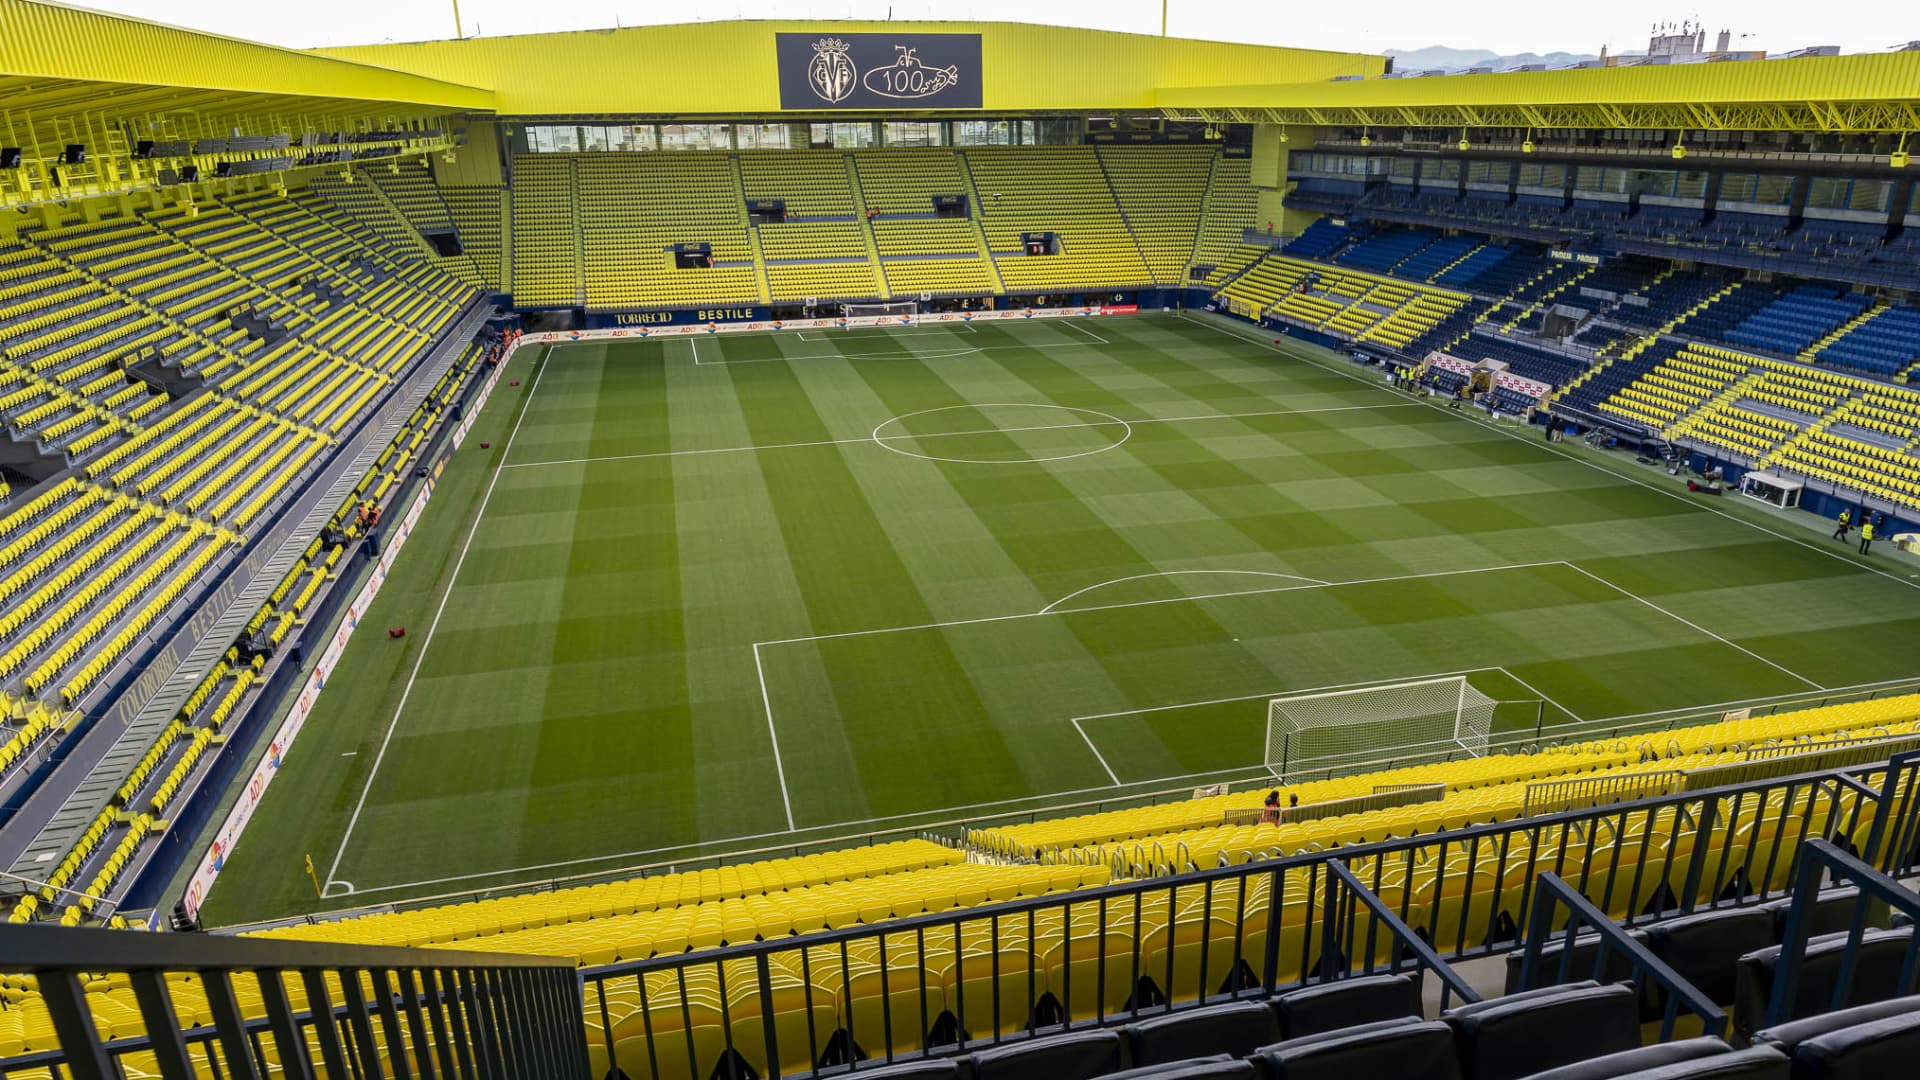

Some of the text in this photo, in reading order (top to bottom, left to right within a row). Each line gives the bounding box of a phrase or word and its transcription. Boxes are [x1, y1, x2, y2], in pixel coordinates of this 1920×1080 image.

[883, 70, 923, 92] 100
[614, 308, 753, 325] TORRECID BESTILE
[189, 579, 237, 642] BESTILE
